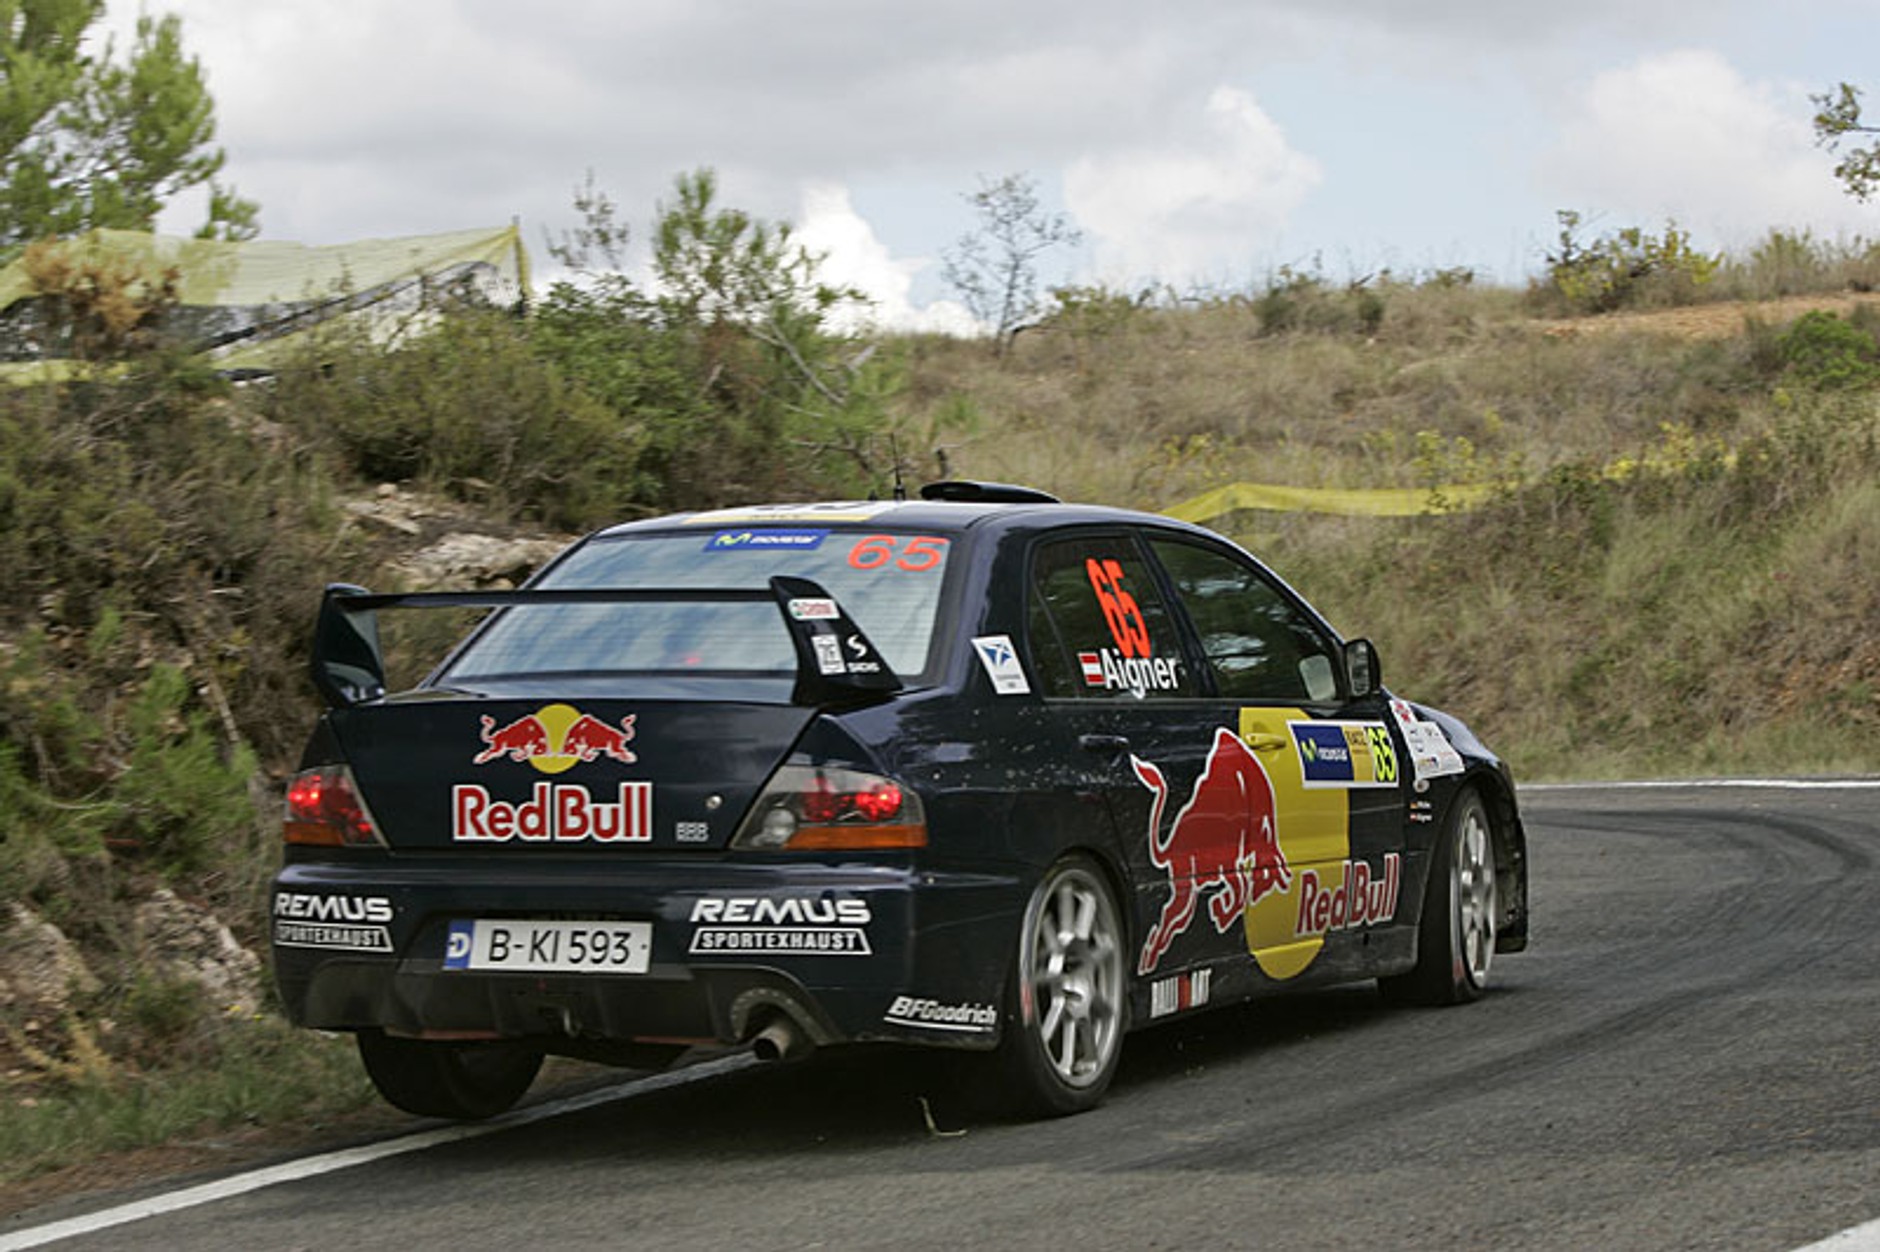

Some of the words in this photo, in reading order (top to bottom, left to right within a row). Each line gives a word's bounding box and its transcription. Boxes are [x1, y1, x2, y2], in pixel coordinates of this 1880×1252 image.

[847, 534, 951, 572] 65
[1085, 558, 1151, 659] 65
[1100, 648, 1182, 699] Aigner
[1367, 727, 1397, 781] 65
[274, 892, 393, 922] REMUS
[689, 898, 871, 924] REMUS
[447, 932, 473, 959] D
[568, 930, 631, 965] 593
[702, 931, 857, 950] SPORTEXHAUST
[888, 996, 997, 1024] BFGoodrich
